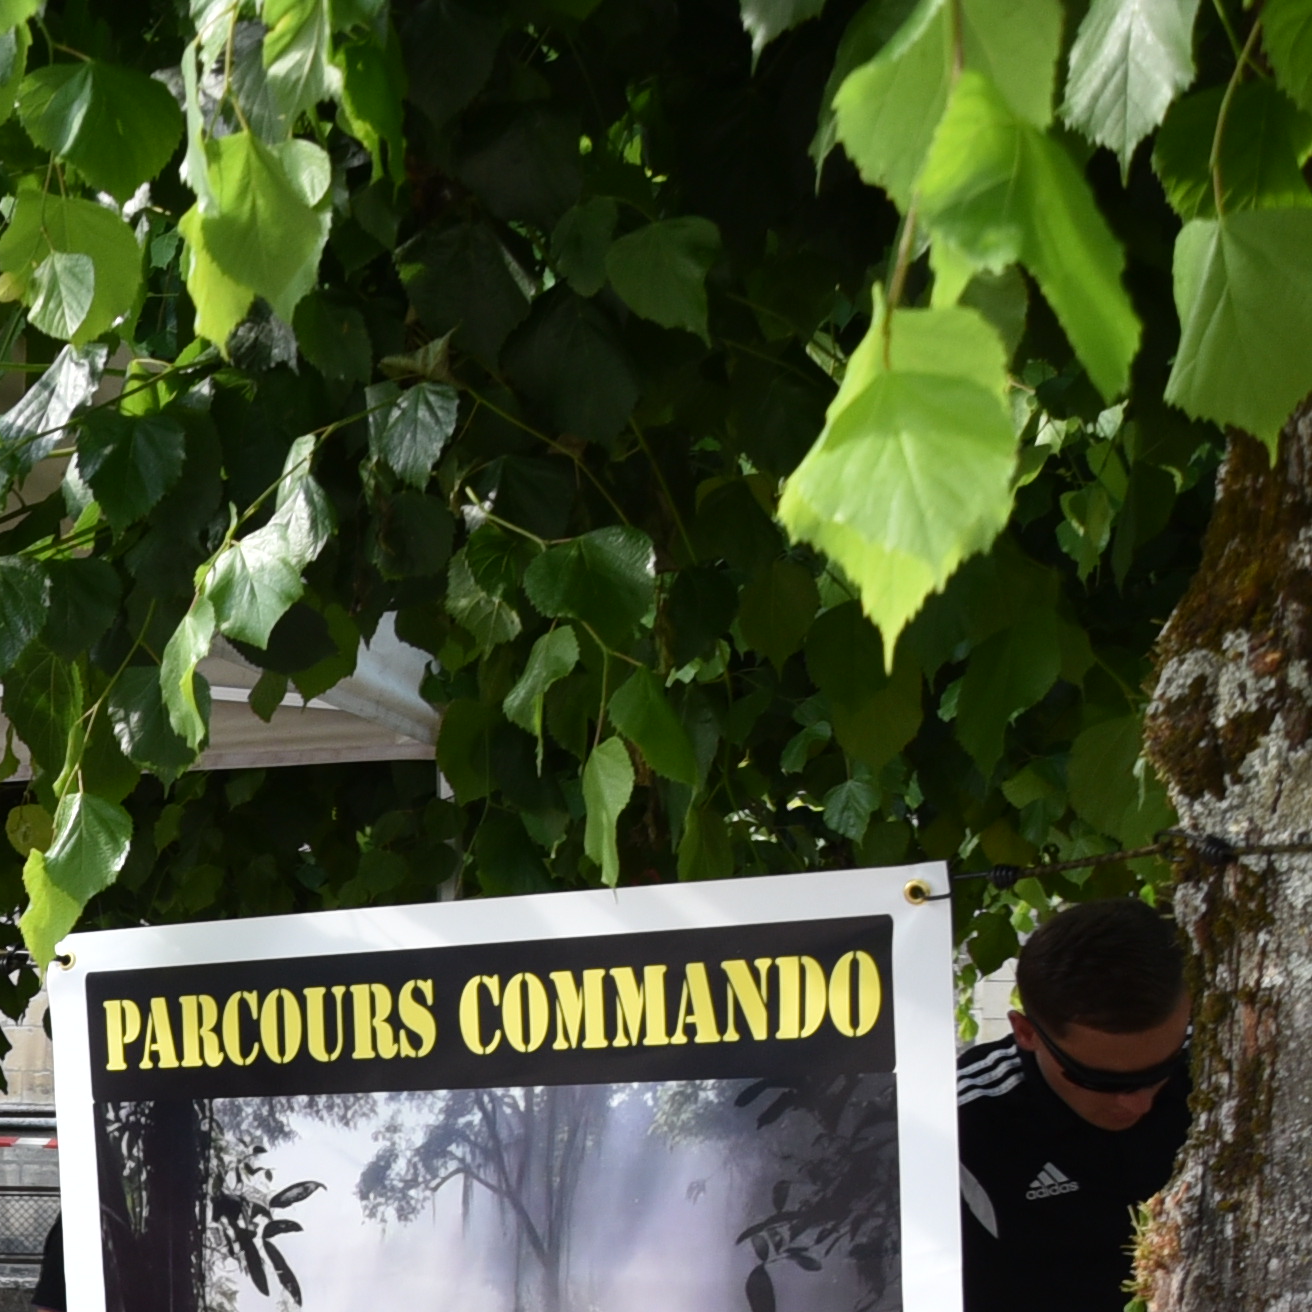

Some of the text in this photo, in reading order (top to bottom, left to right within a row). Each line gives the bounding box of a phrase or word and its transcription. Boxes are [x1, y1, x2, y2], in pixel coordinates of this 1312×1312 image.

[103, 950, 882, 1071] PARCOURS COMMANDO
[1025, 1181, 1079, 1200] adidas
